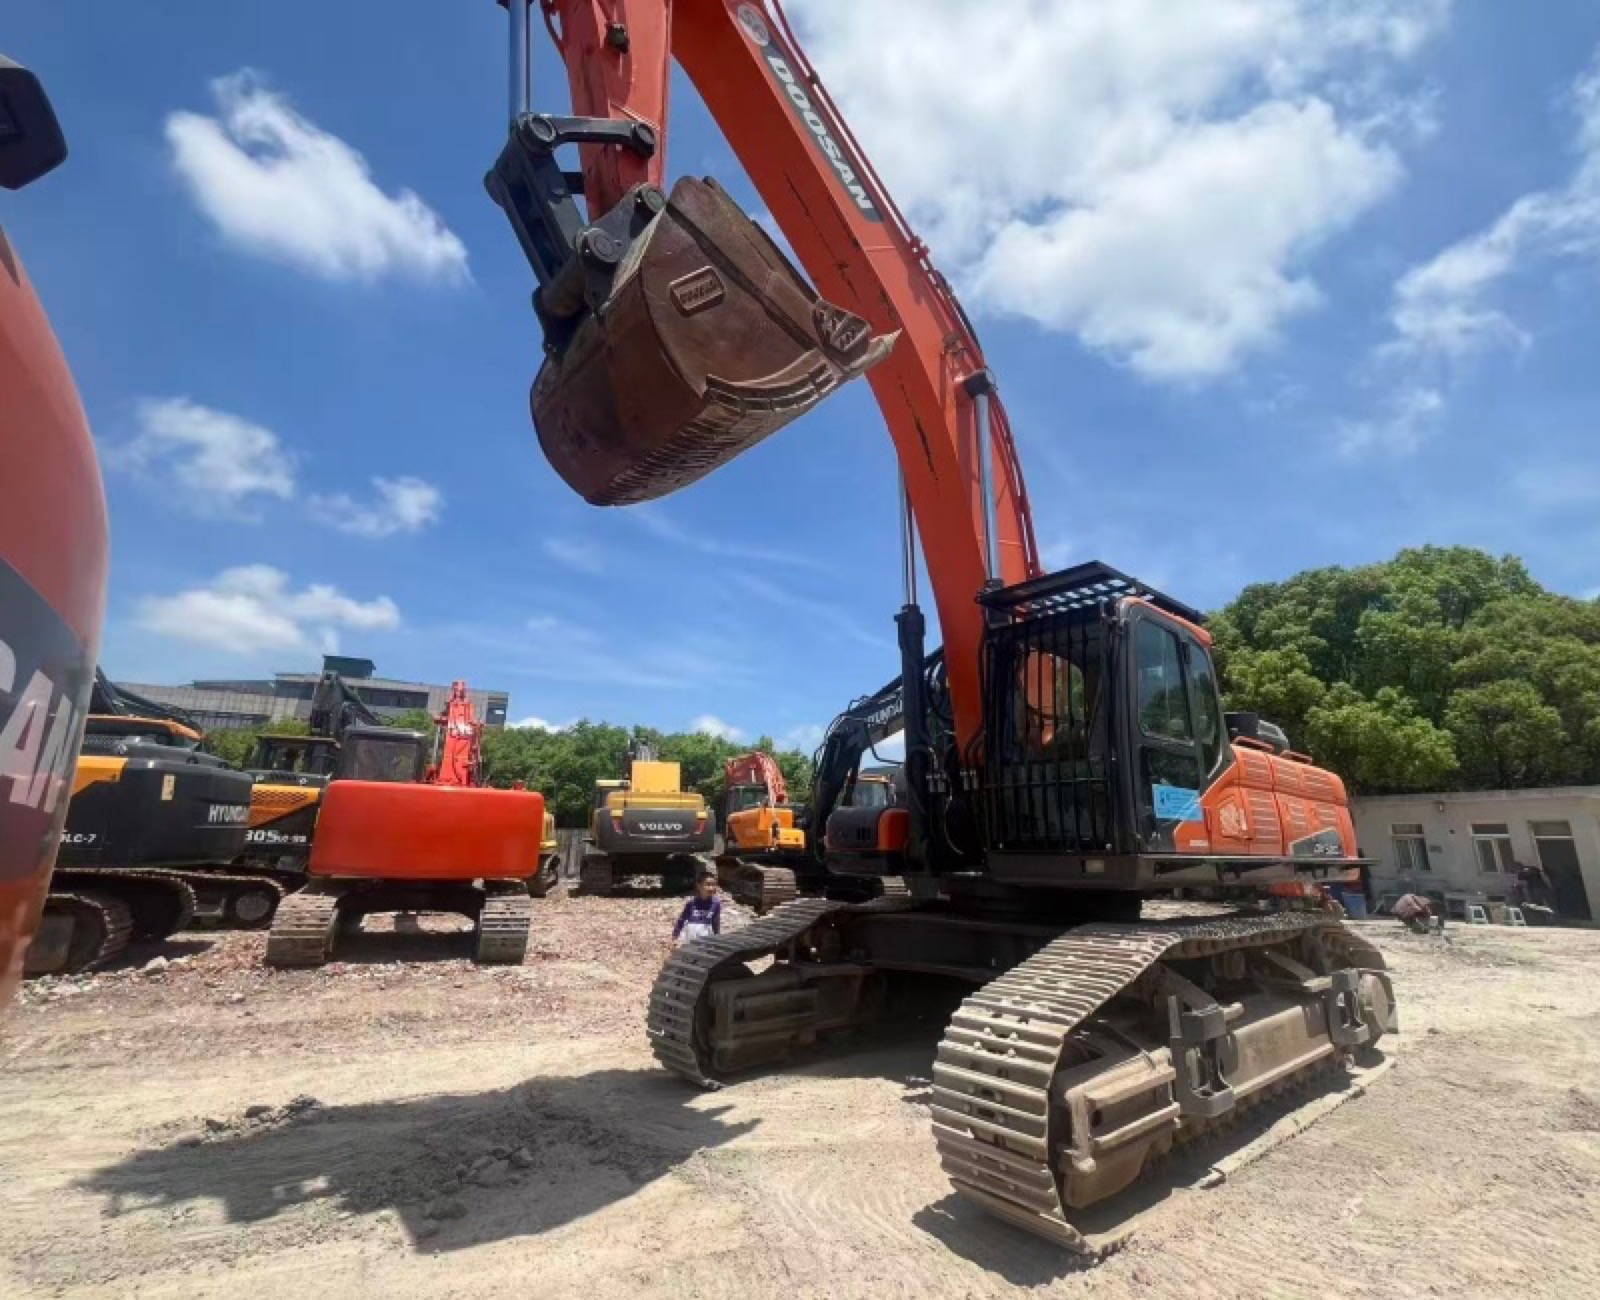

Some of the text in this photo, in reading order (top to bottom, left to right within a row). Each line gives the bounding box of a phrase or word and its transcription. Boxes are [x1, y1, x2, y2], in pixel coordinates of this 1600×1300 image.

[767, 55, 874, 210] DOOSAN
[0, 640, 79, 813] AN
[638, 822, 683, 831] VOLVO
